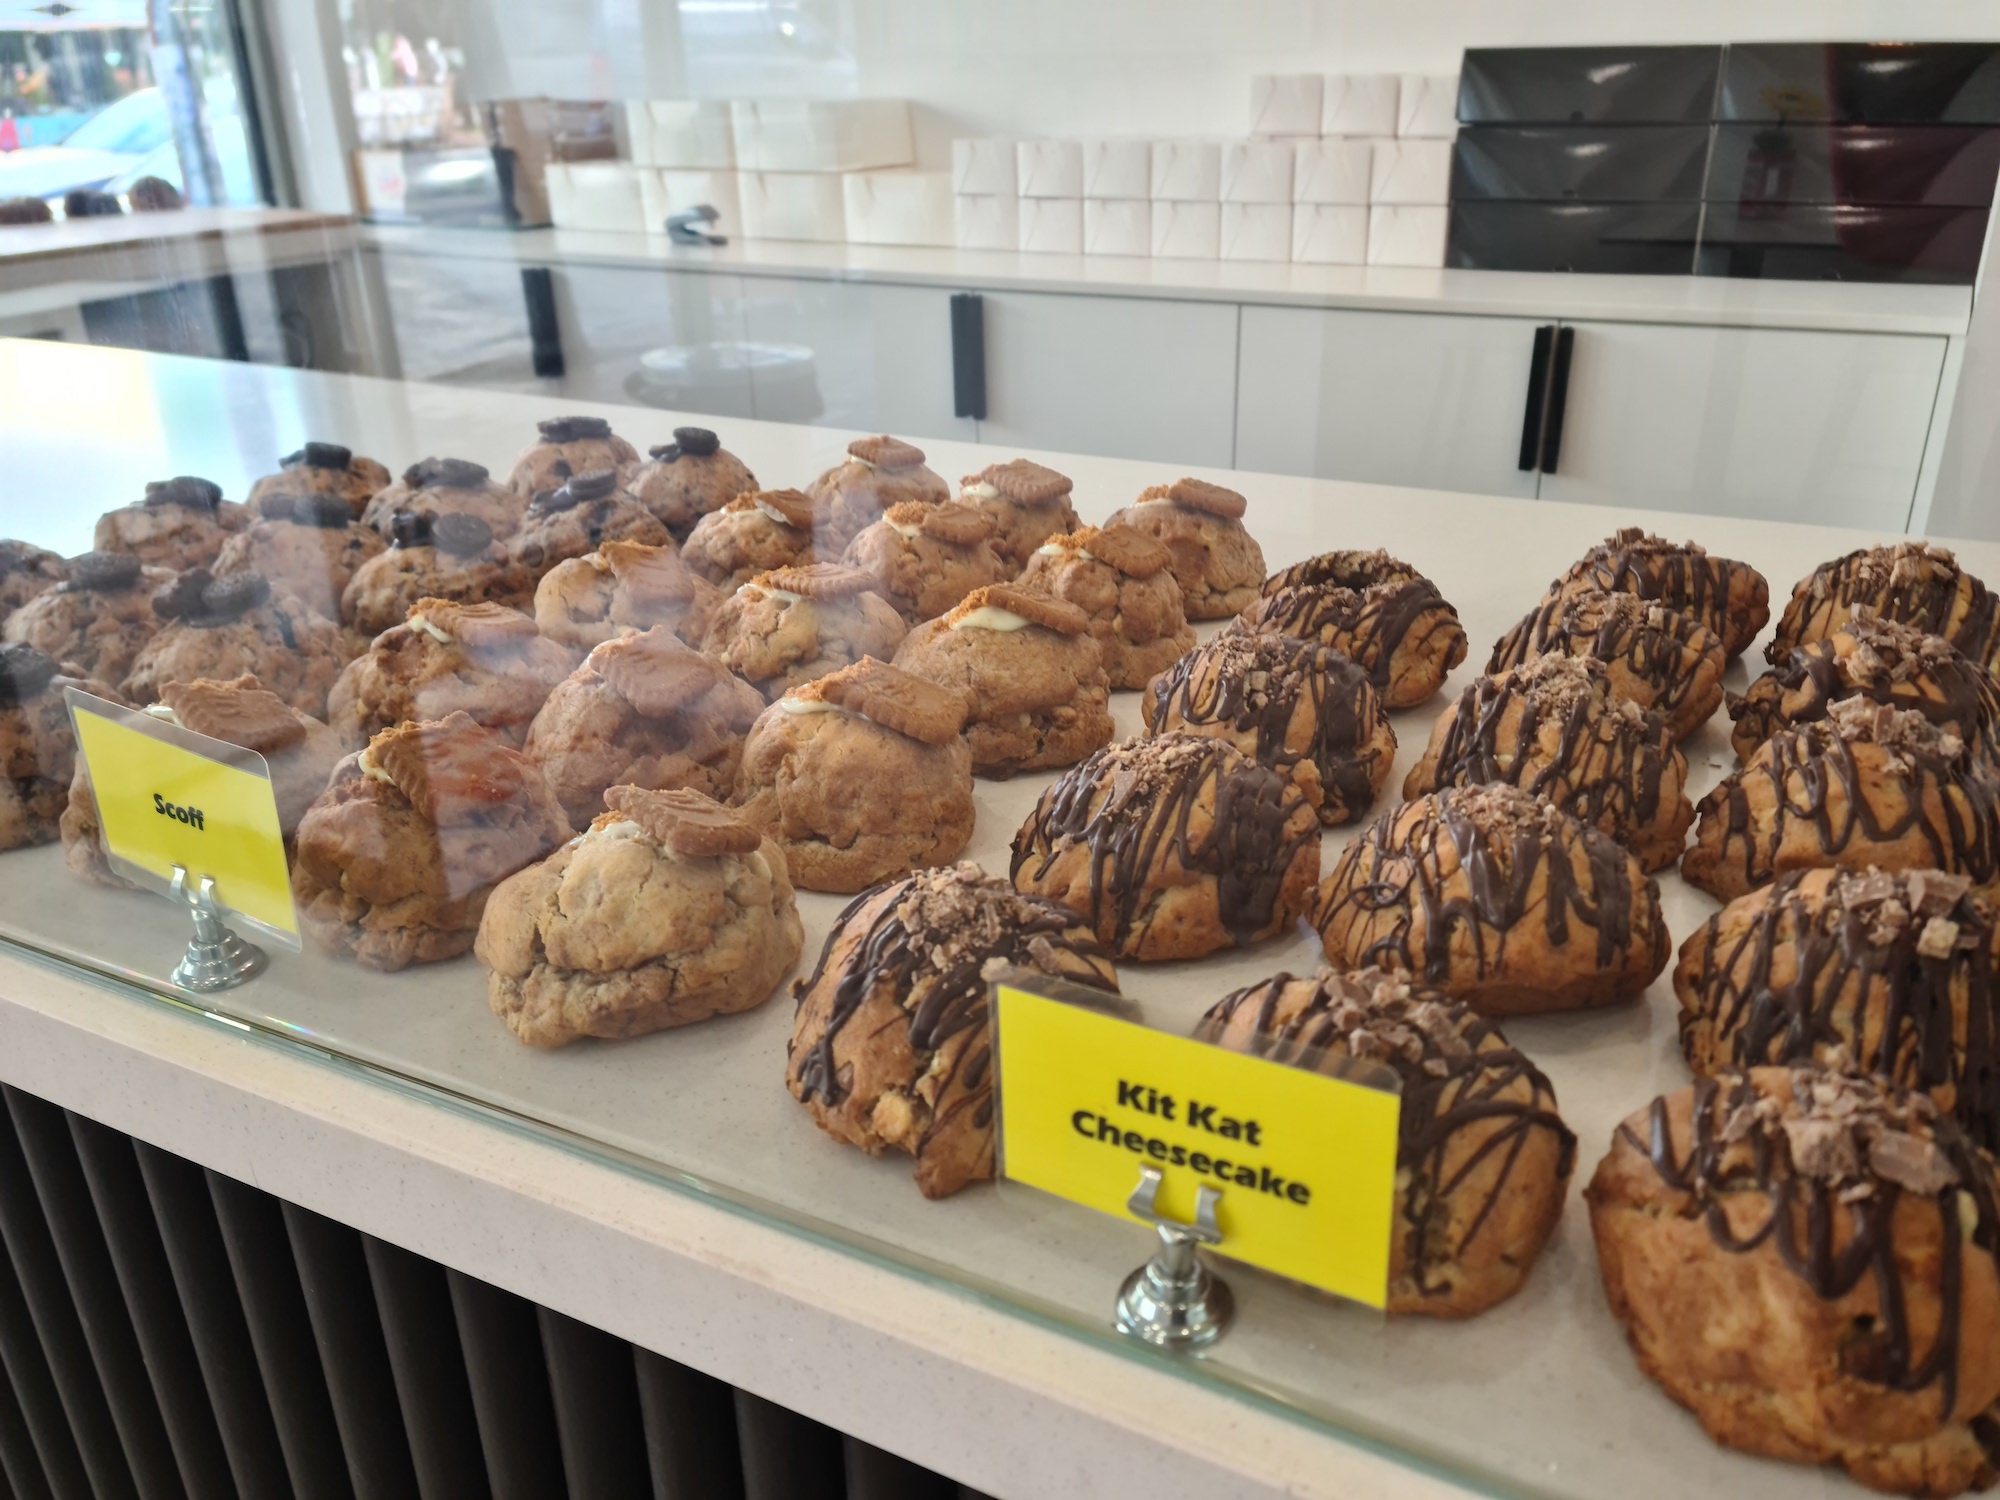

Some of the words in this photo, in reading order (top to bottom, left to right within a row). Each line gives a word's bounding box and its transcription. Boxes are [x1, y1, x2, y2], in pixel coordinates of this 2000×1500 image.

[153, 793, 204, 831] Scoff
[1117, 1080, 1176, 1121] Kit
[1187, 1100, 1262, 1146] Kat
[1072, 1110, 1311, 1206] Cheesecake
